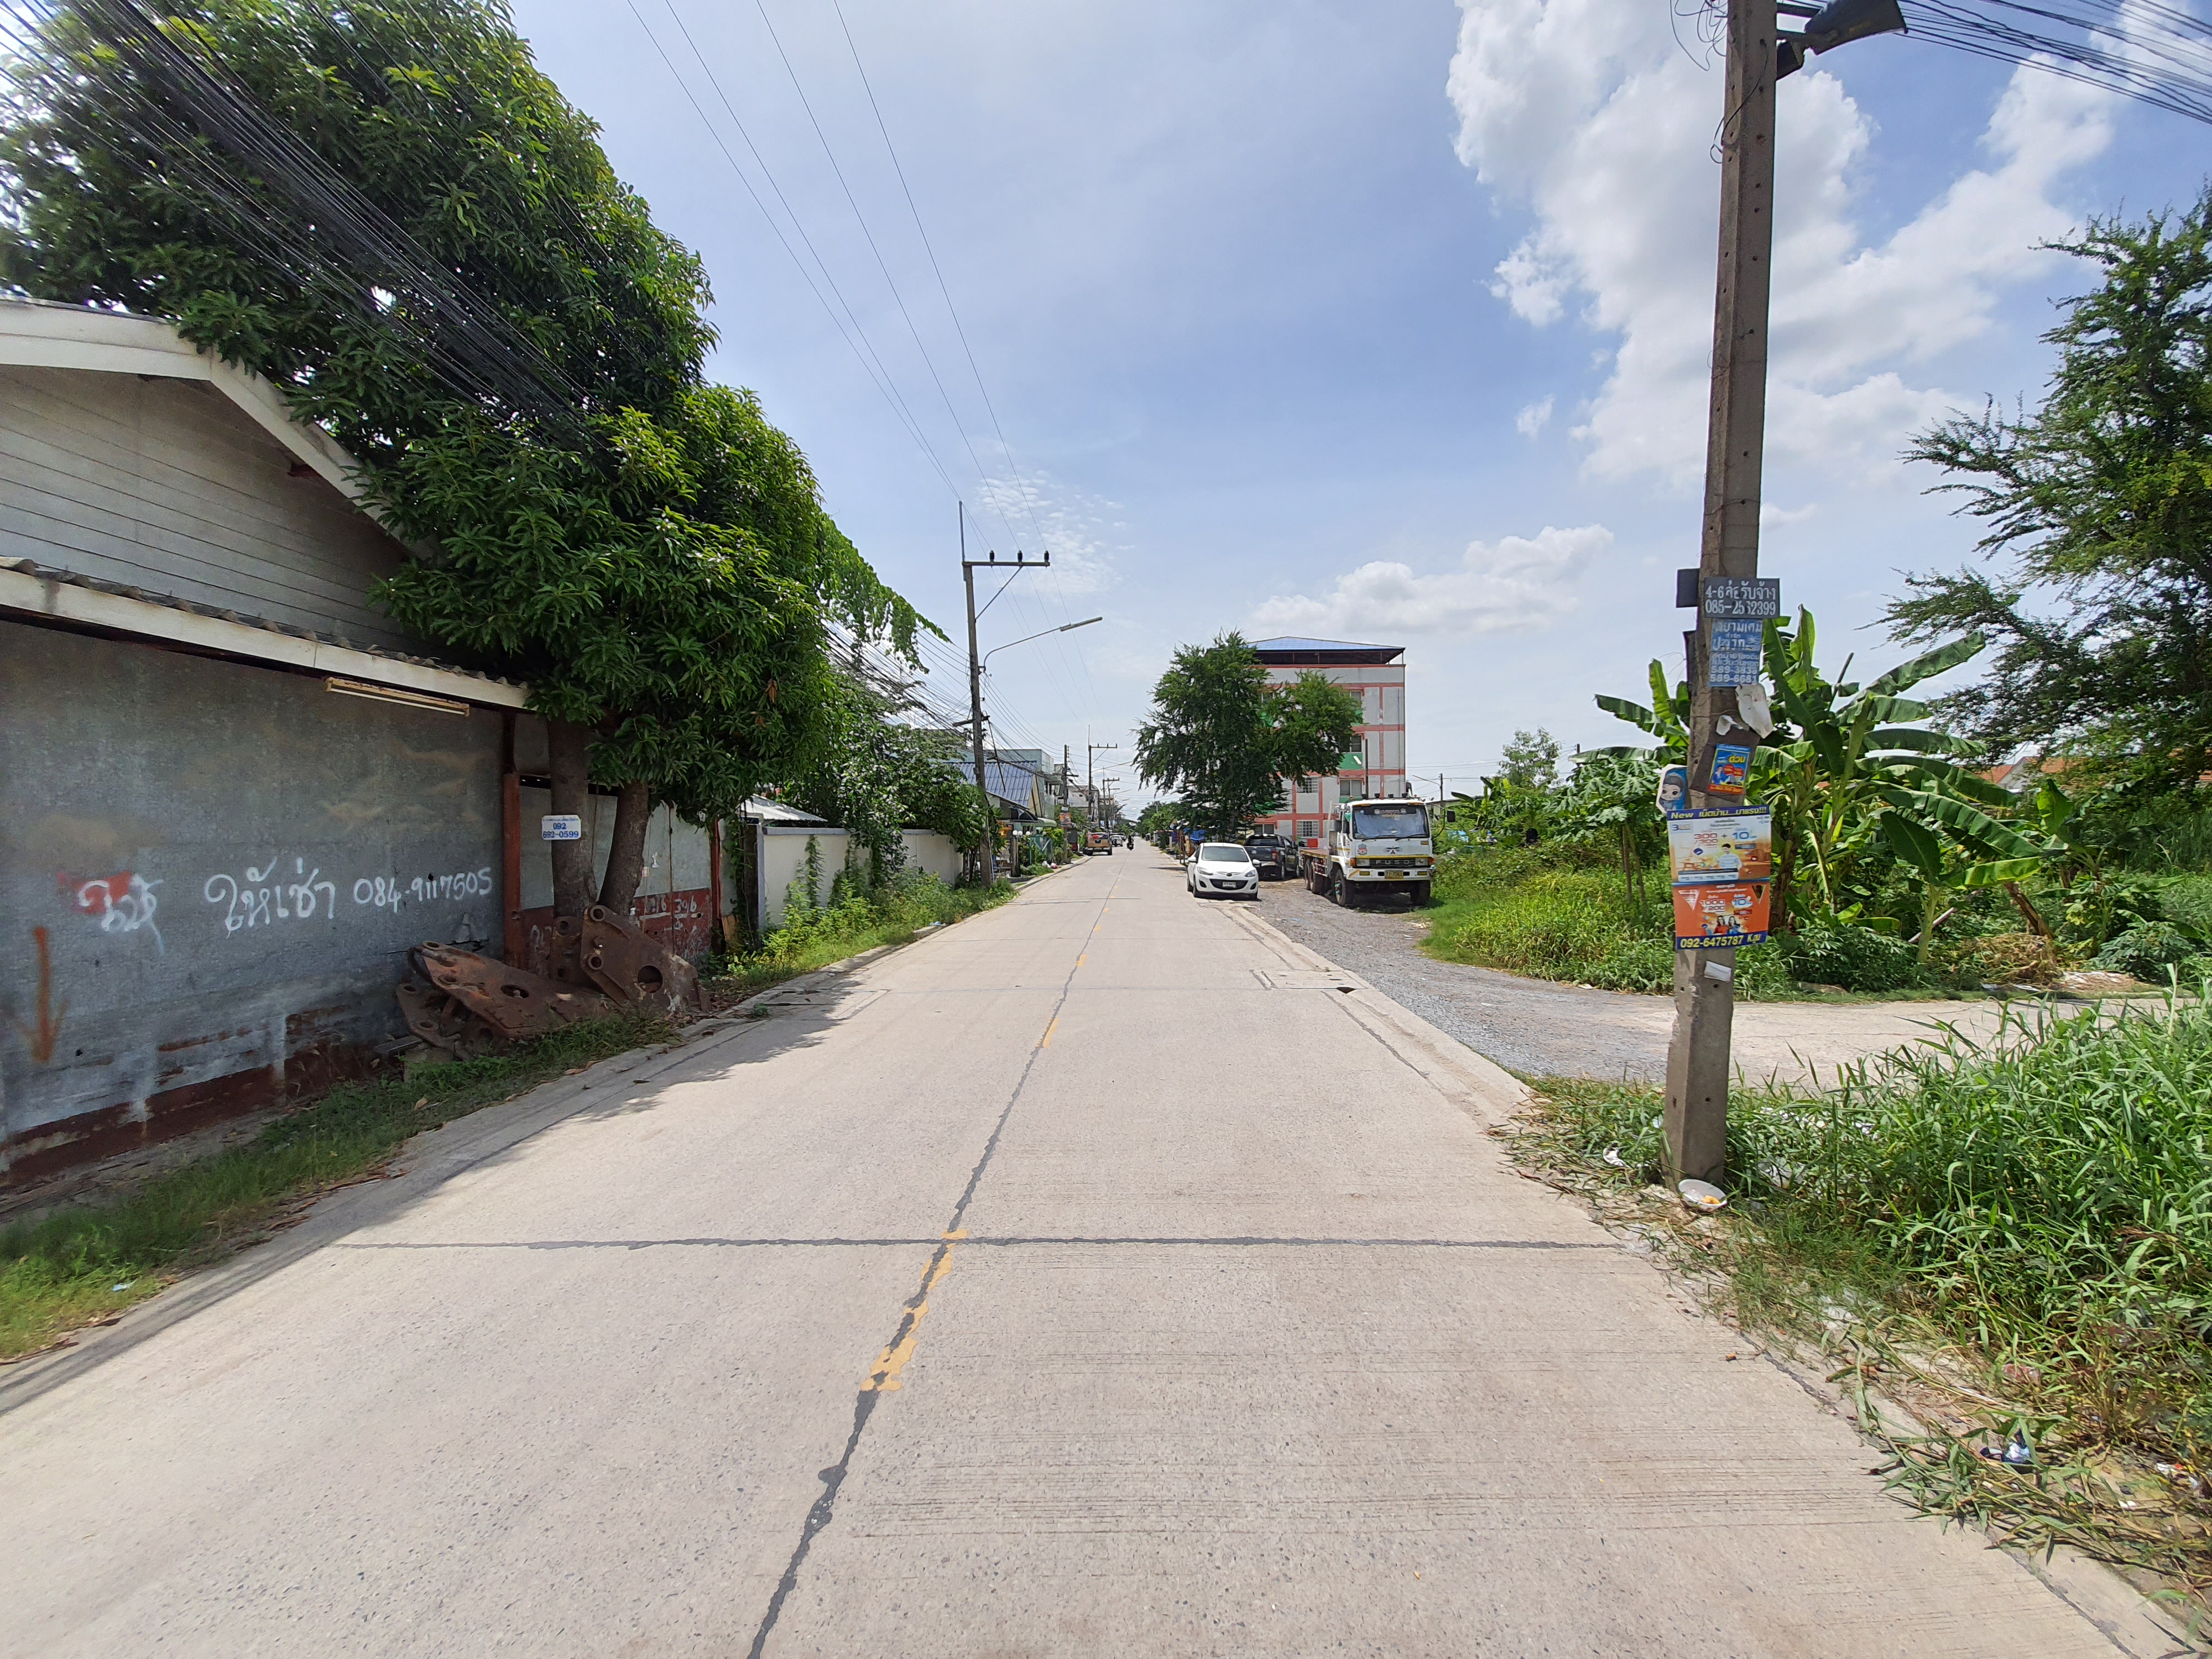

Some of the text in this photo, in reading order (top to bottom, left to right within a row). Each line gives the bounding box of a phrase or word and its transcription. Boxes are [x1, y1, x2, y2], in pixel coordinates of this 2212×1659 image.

[1709, 674, 1757, 684] 589-6681
[1732, 832, 1750, 840] 10
[204, 857, 336, 938] ให้เช่า
[1680, 936, 1744, 948] 092-6475787
